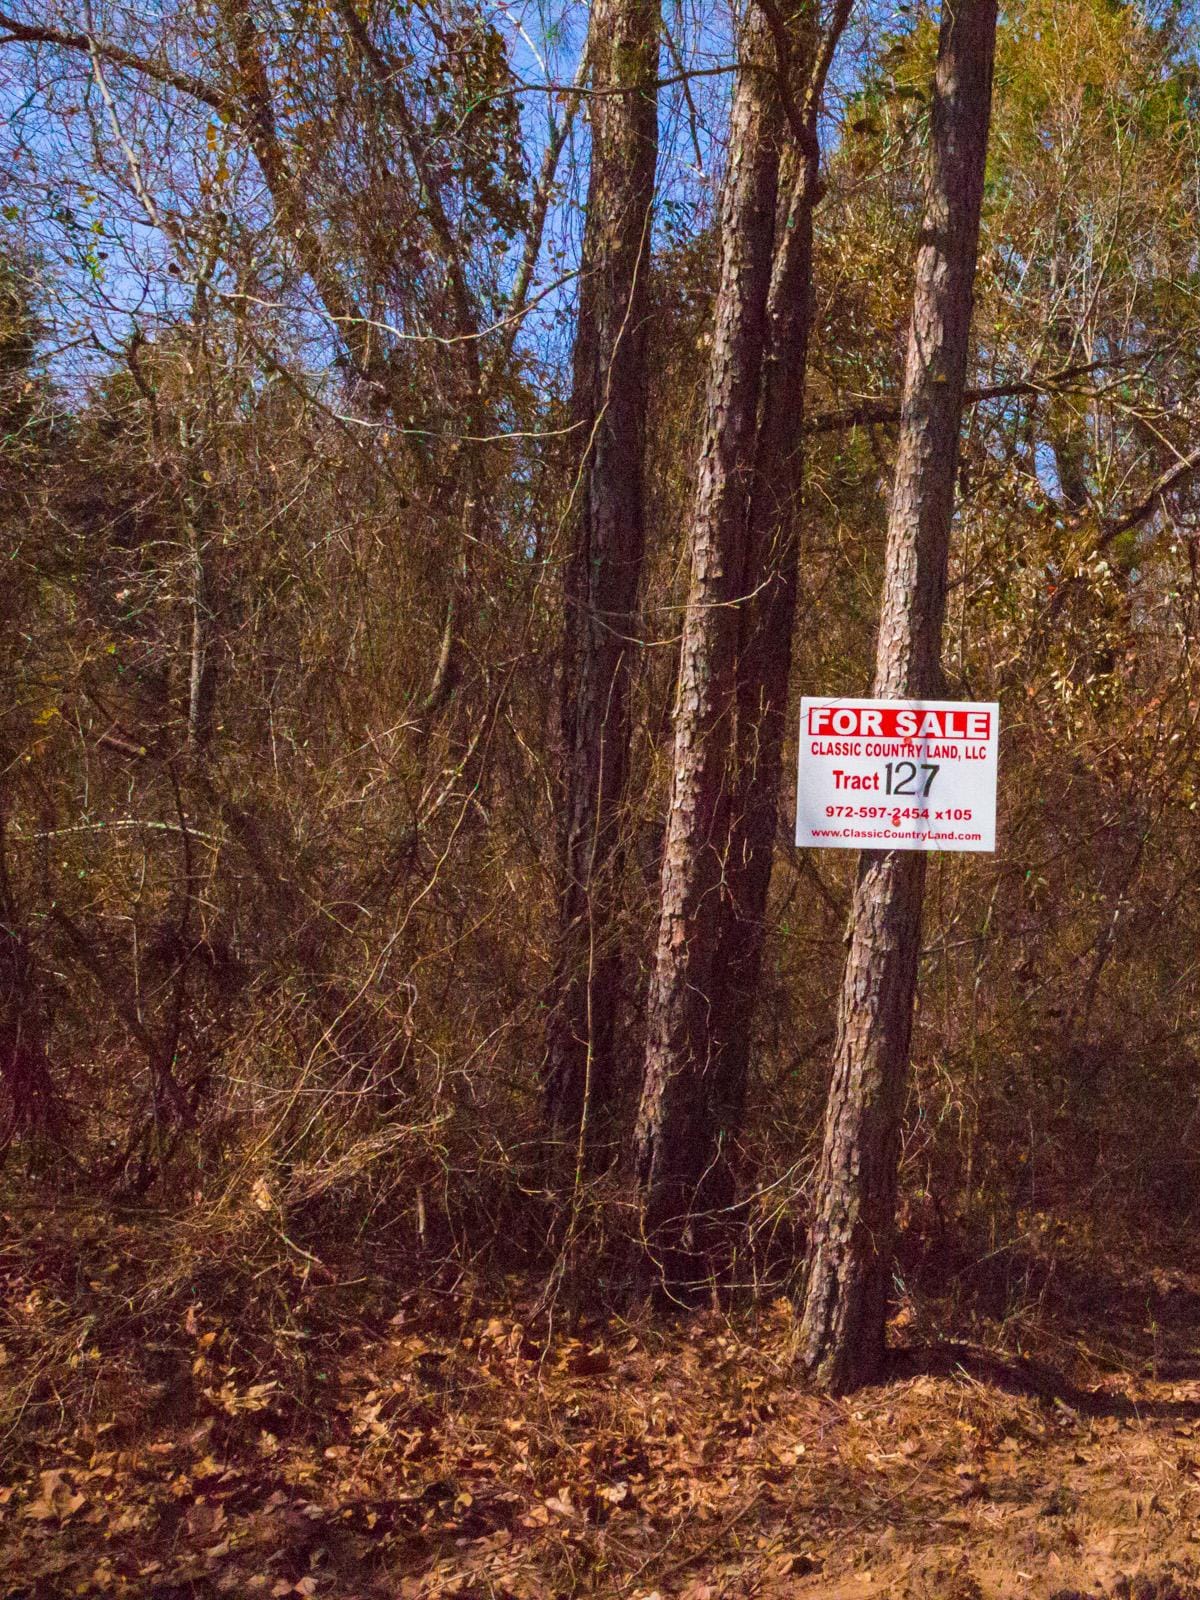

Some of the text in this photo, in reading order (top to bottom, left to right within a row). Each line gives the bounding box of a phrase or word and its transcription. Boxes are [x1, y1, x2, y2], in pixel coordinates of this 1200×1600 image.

[810, 708, 988, 738] FOR SALE
[811, 742, 987, 761] CLASSIC COUNTRY LAND, LLC
[832, 761, 940, 797] Tract 127
[825, 806, 972, 821] 972-597-2454 x105
[811, 828, 981, 841] www.ClassicCountryLand.com
